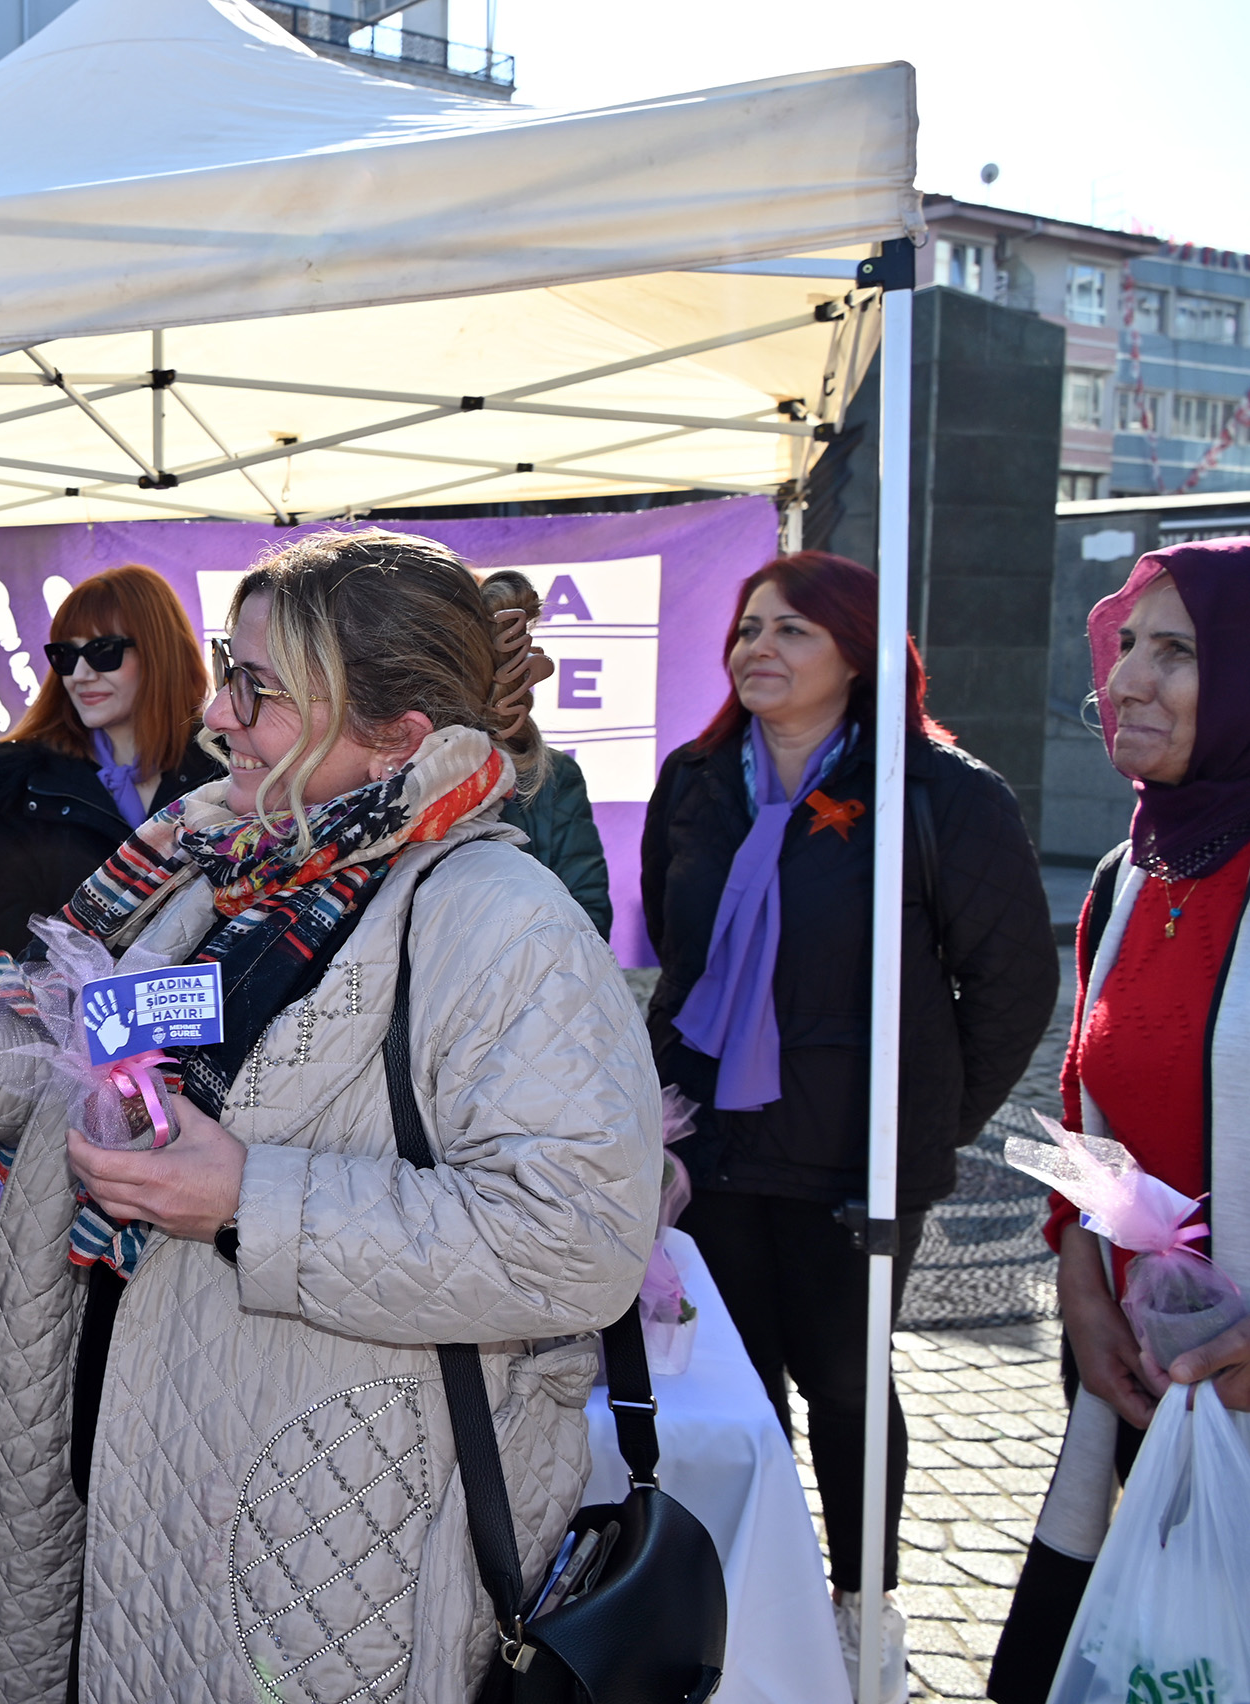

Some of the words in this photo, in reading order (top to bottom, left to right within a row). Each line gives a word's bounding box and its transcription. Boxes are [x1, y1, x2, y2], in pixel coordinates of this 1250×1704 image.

[146, 977, 203, 993] KADINA
[146, 992, 206, 1010] ŞİDDETE
[152, 1008, 203, 1021] HAYIR!
